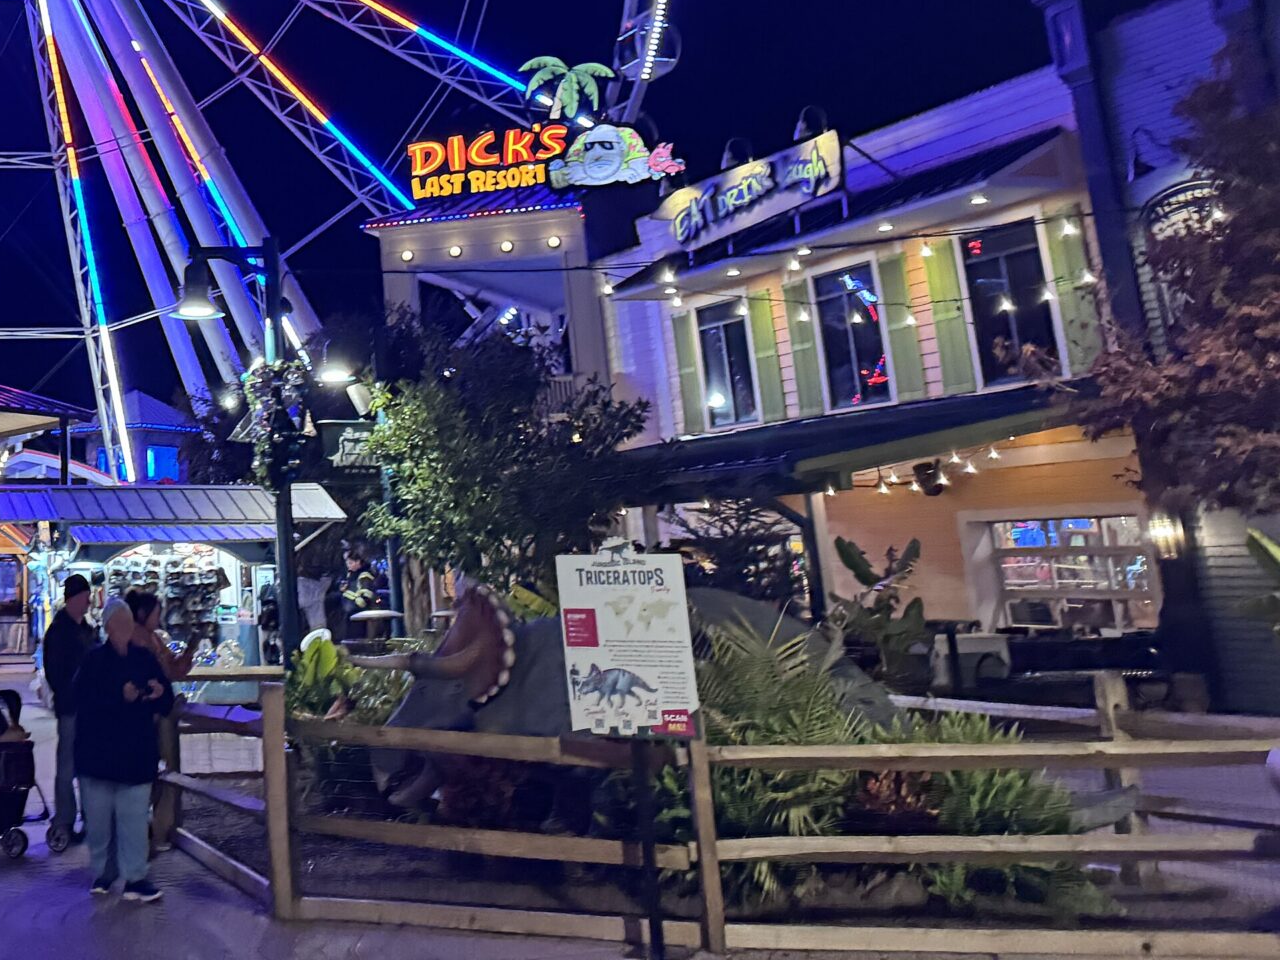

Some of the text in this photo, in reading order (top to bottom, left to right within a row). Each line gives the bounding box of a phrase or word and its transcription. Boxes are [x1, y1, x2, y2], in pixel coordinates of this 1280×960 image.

[408, 123, 568, 176] DICK'S
[411, 164, 546, 200] LAST RESORT
